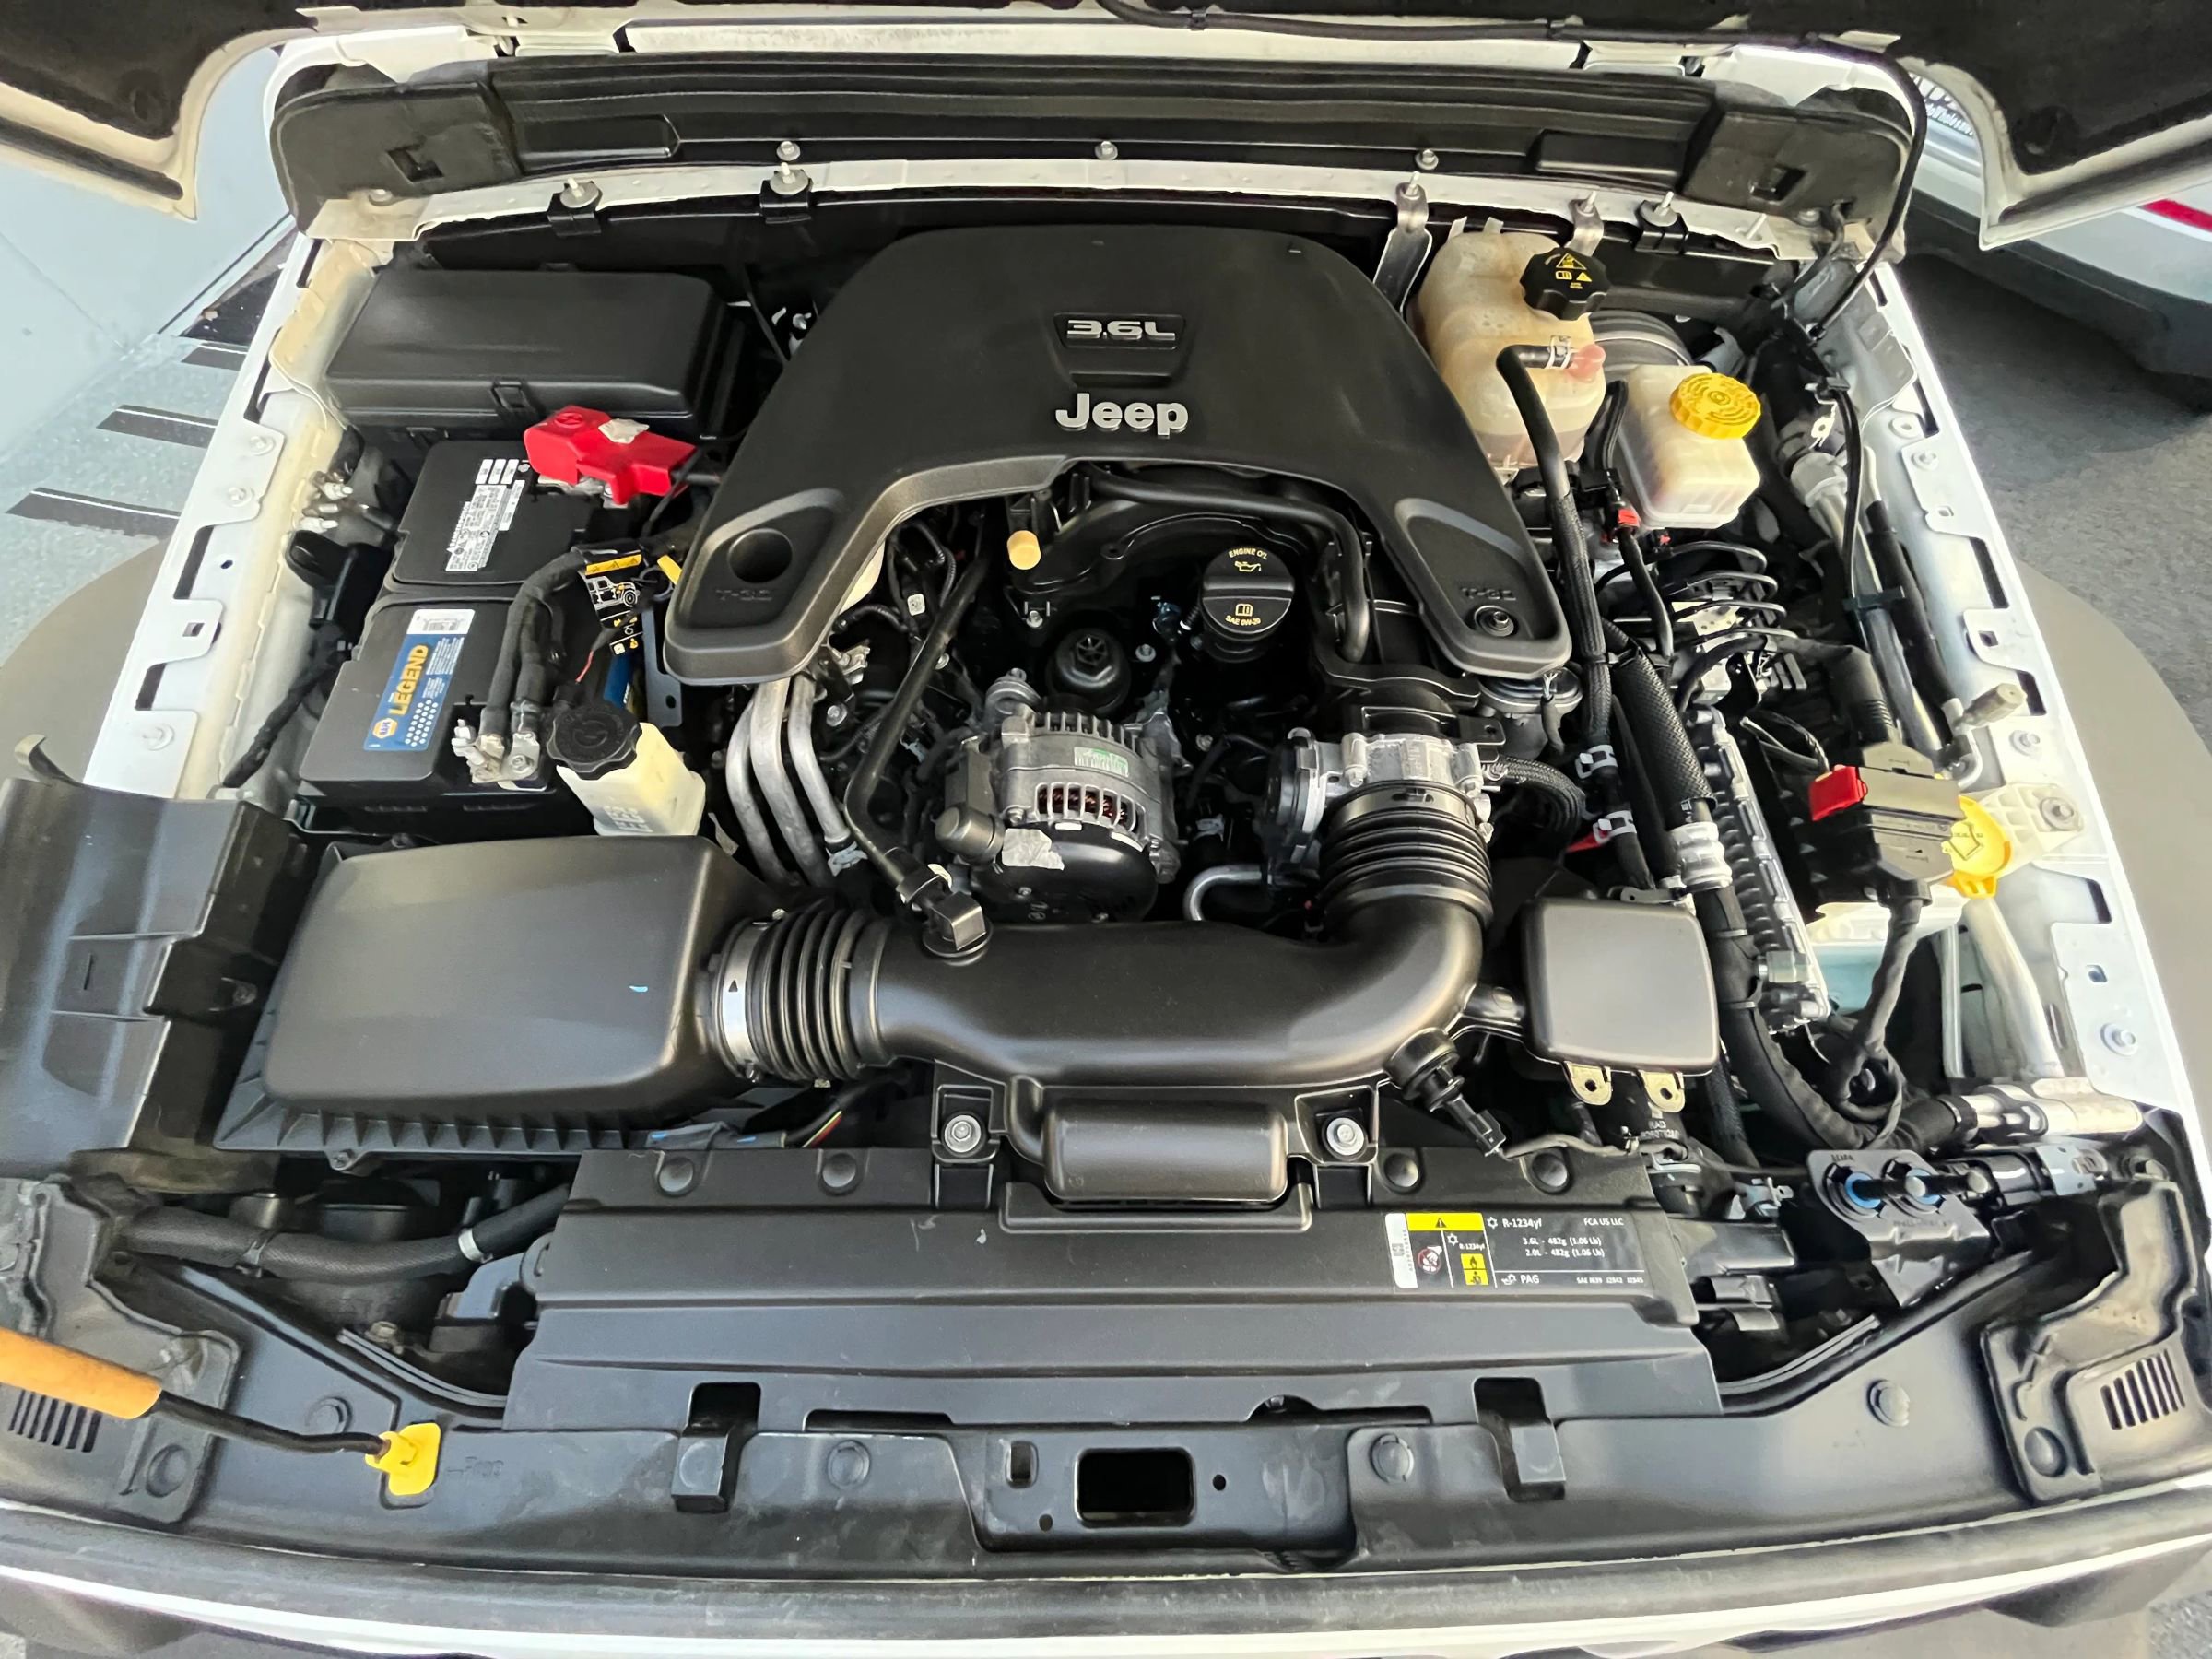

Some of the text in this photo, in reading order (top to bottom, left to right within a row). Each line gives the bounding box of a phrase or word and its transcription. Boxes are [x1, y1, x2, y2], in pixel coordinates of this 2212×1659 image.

[1067, 319, 1176, 340] 3.6L
[1055, 392, 1189, 438] Jeep
[1228, 547, 1268, 560] ENGINE OIL
[388, 644, 429, 716] LEGEND
[1583, 1218, 1625, 1226] FCA US LLC
[1520, 1274, 1540, 1284] PAG
